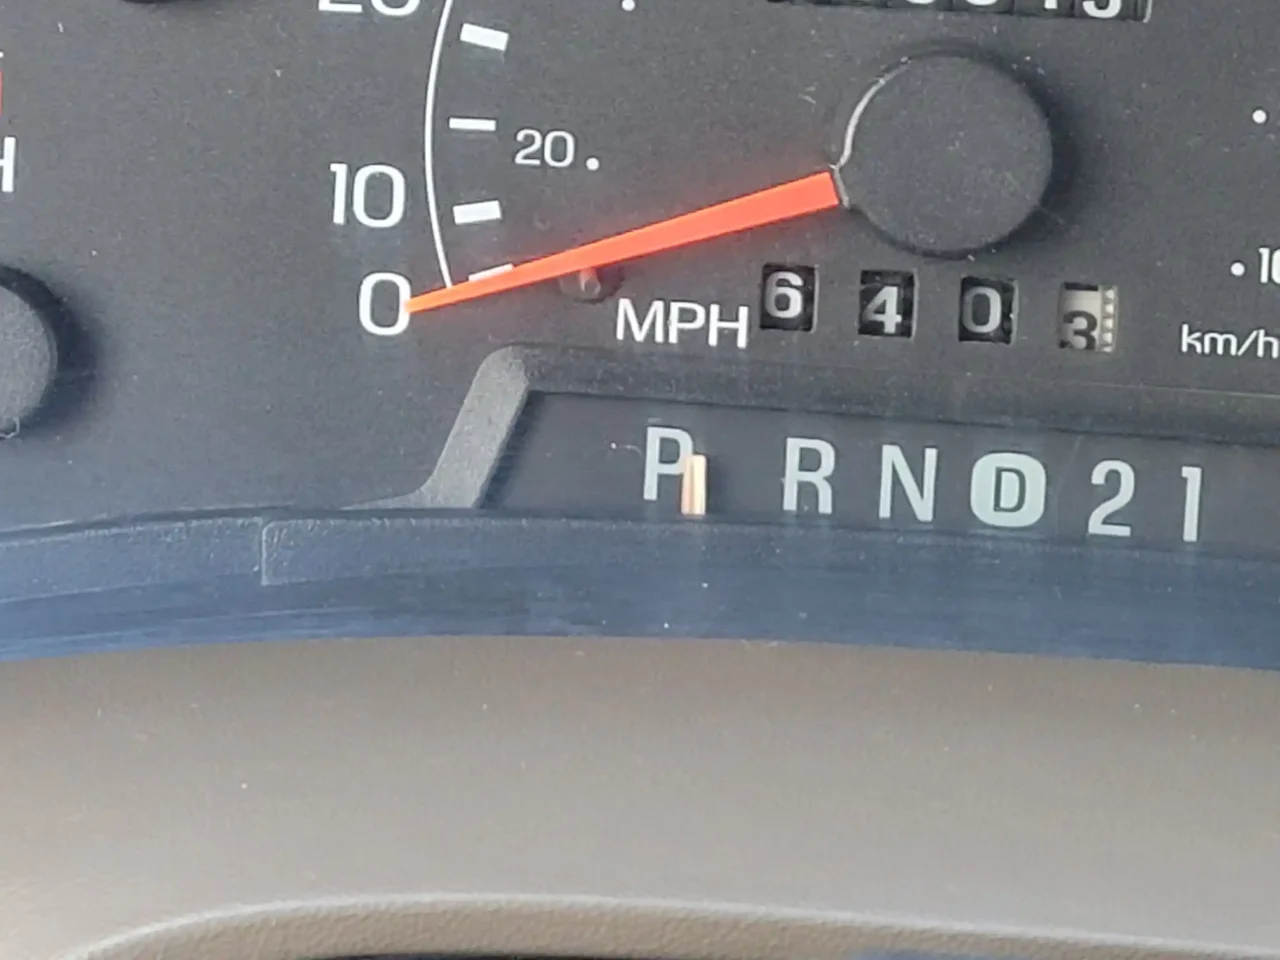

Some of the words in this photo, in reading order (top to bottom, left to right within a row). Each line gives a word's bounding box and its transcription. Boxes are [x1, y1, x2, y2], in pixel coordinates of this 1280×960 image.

[514, 129, 575, 167] 20
[330, 163, 405, 228] 10
[359, 271, 411, 336] 0
[616, 297, 749, 350] MPH
[763, 270, 804, 319] 6
[861, 285, 902, 334] 4
[1181, 323, 1279, 359] km/h
[643, 425, 694, 502] P
[783, 437, 835, 515] R
[879, 444, 938, 522] N
[1088, 460, 1135, 537] 2
[1181, 466, 1202, 542] 1
